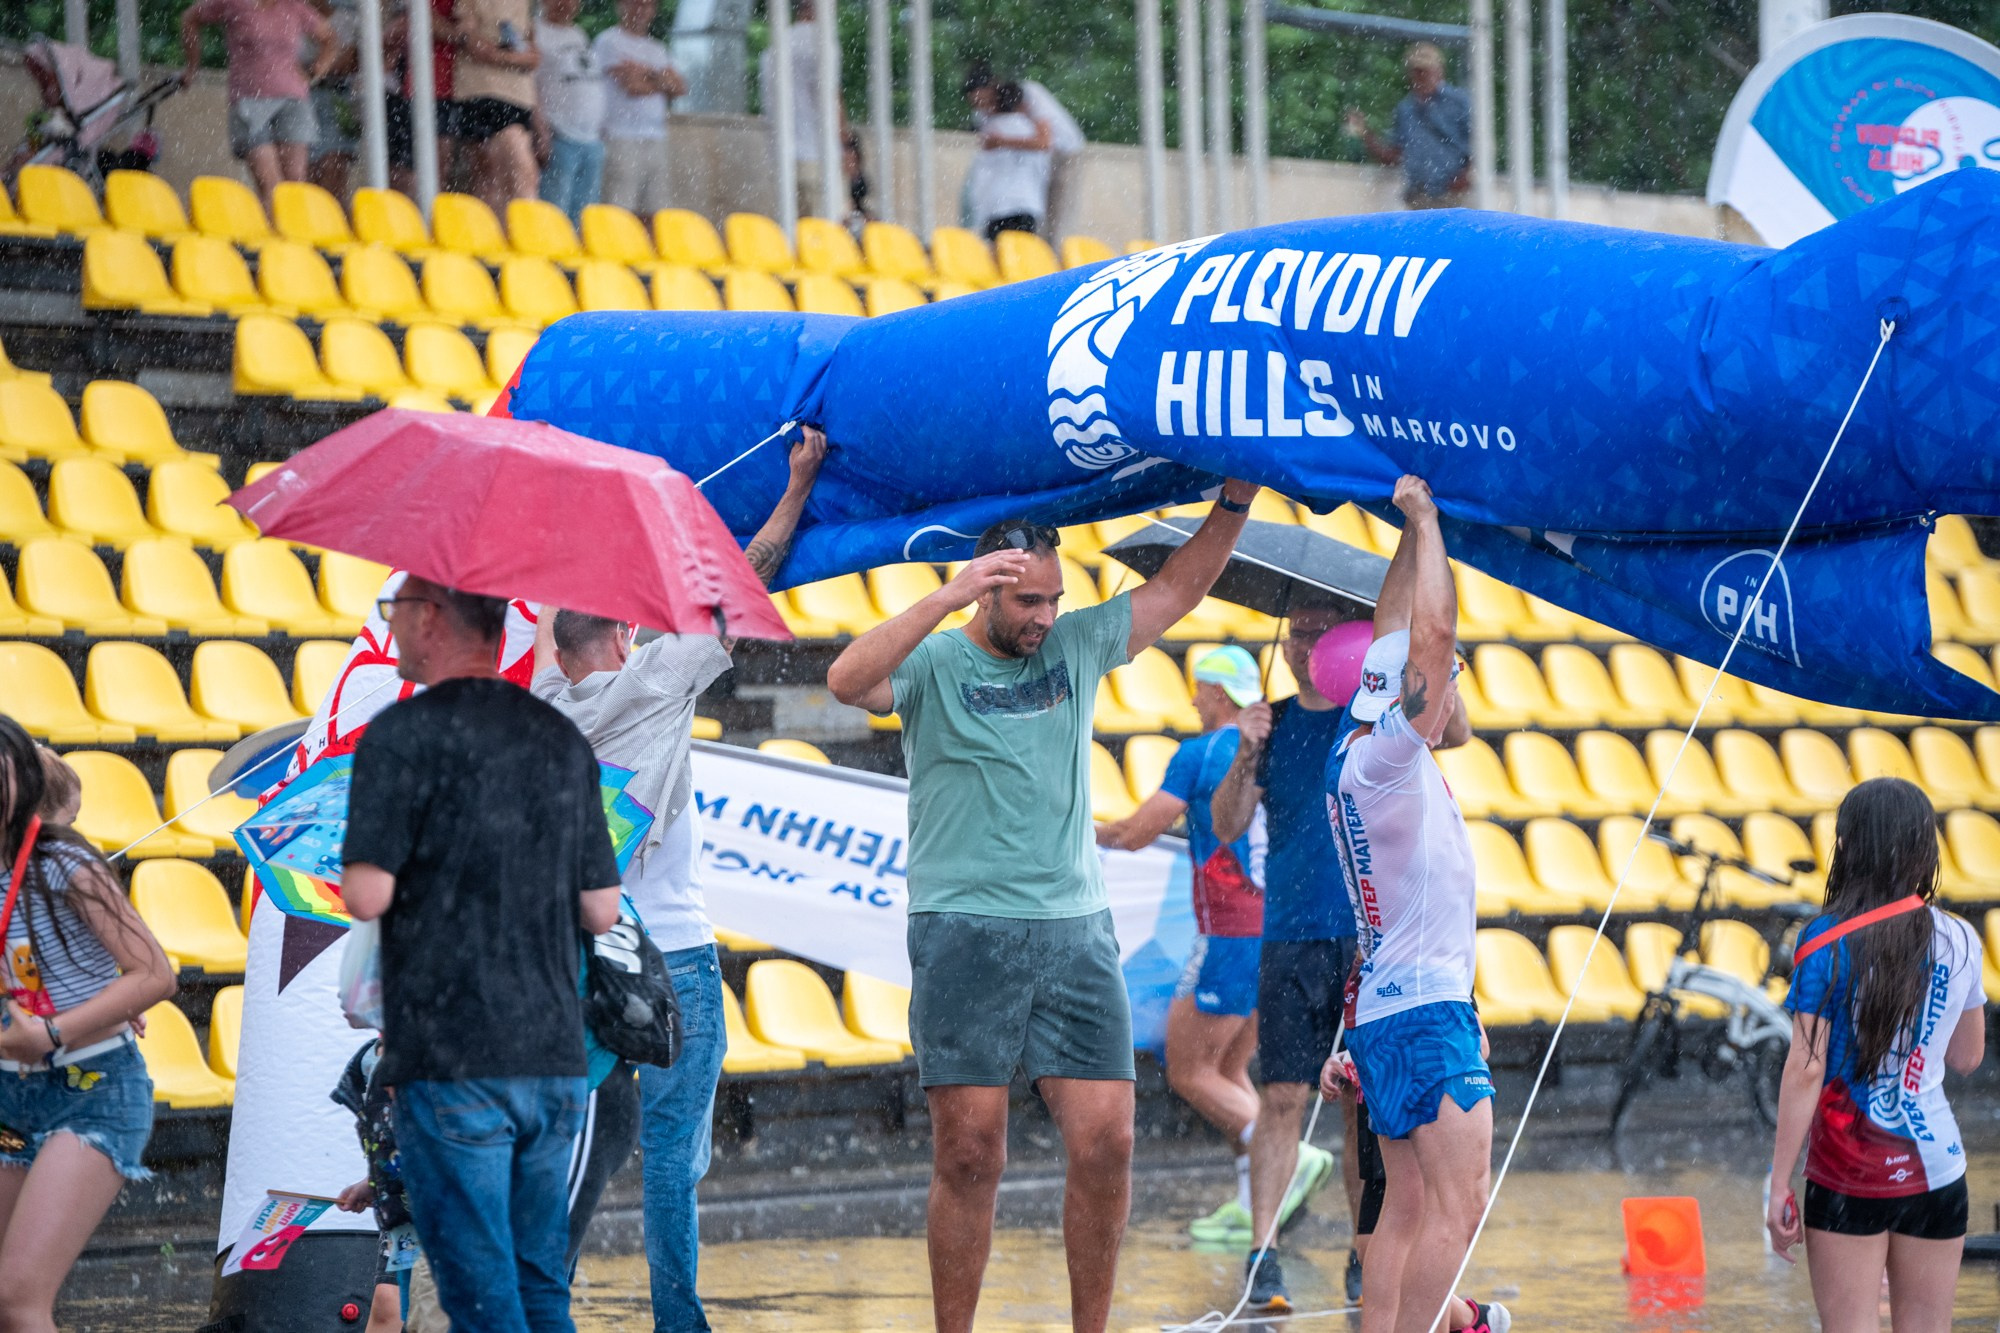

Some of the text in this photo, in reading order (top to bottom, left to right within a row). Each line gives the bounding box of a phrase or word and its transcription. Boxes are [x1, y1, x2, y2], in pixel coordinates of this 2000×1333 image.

[1170, 248, 1452, 337] PLOVDIV
[1156, 350, 1354, 436] HILLS
[1352, 373, 1383, 400] IN
[1361, 413, 1516, 451] MARKOVO
[1341, 791, 1373, 875] MATTERS
[1360, 878, 1381, 927] STEP
[1904, 1046, 1925, 1093] STEP
